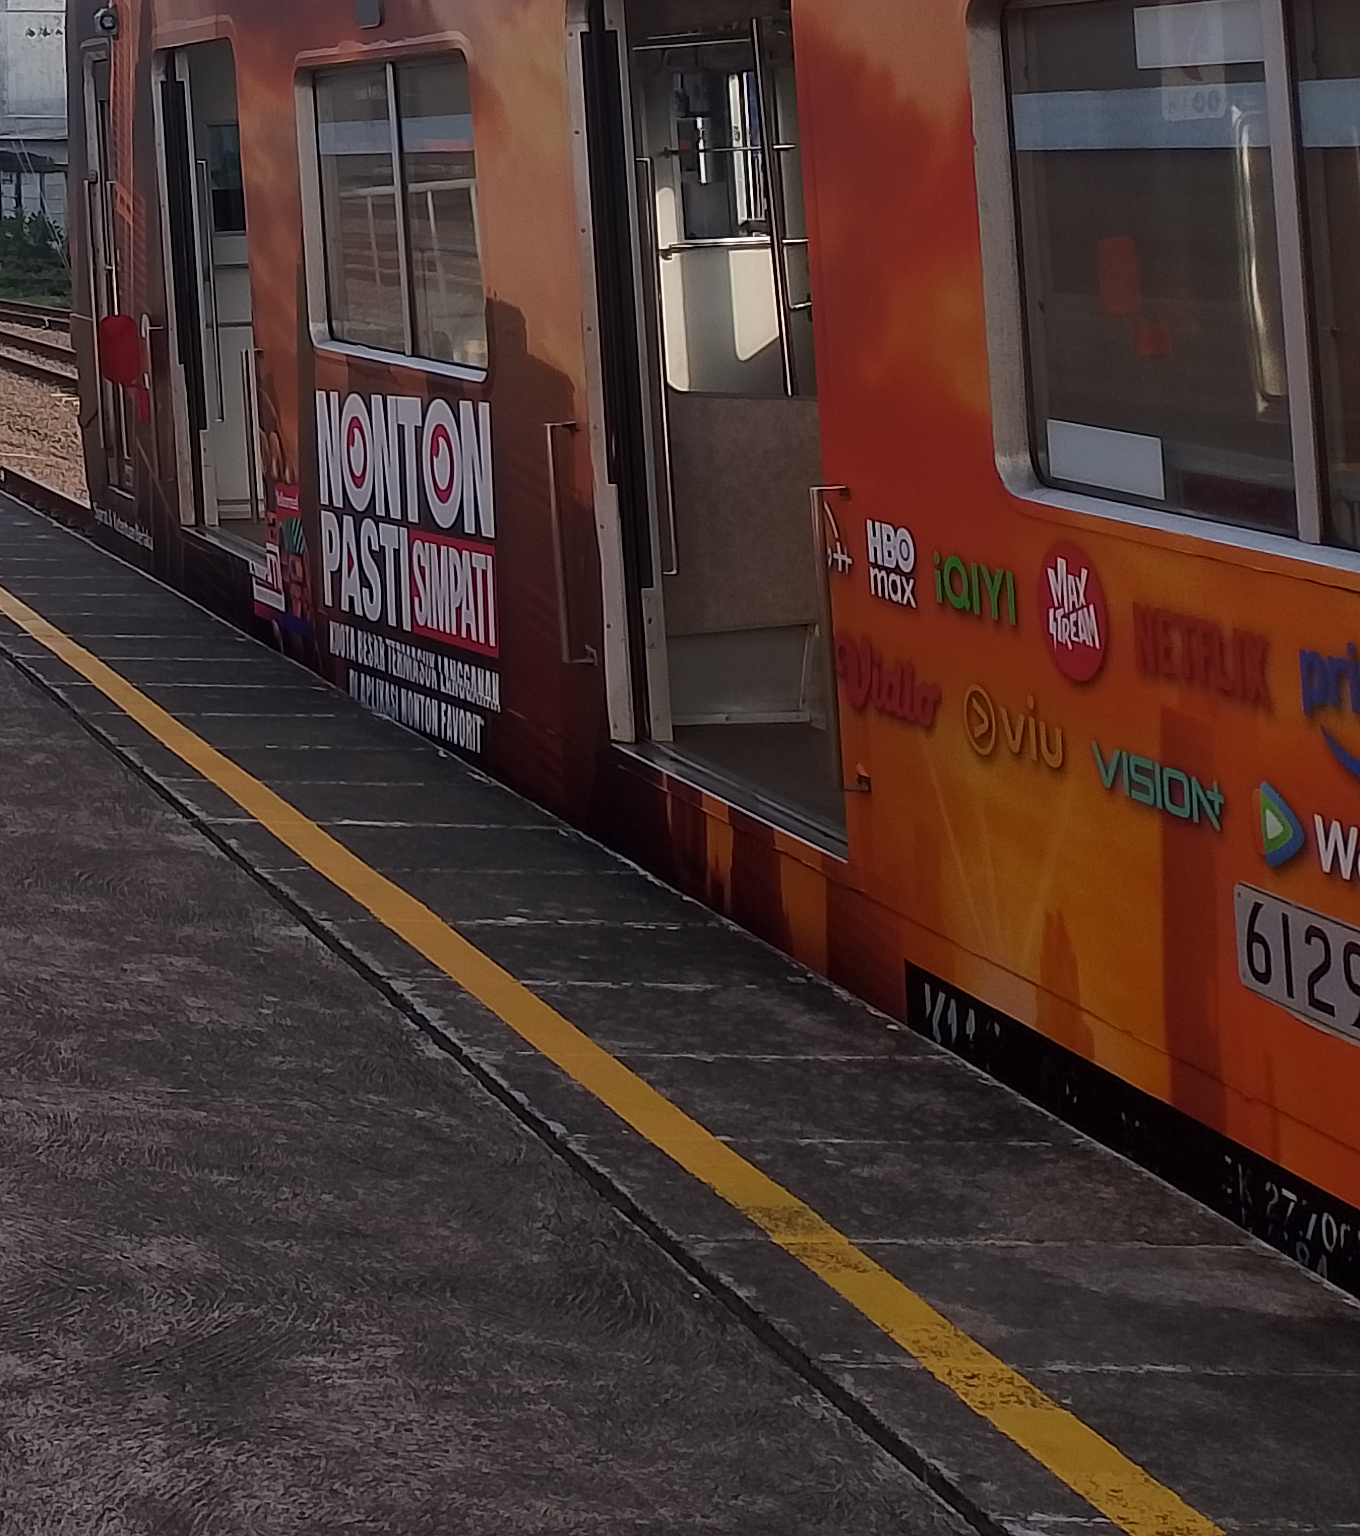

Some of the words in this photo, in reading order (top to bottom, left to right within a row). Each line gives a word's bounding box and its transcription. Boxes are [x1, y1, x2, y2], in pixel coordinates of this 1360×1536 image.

[315, 390, 496, 539] NONTON
[320, 510, 412, 632] PASTI
[412, 539, 497, 647] SIMPATI
[866, 519, 916, 573] HBO
[869, 566, 917, 609] max
[933, 550, 1017, 626] iQIYI
[1046, 556, 1090, 613] MAX
[1048, 603, 1101, 651] STREAM
[1136, 604, 1270, 707] NETFLIX
[329, 620, 356, 661] KUOTA
[357, 629, 386, 673] BESAR
[386, 639, 439, 690] TERMASUK
[438, 655, 502, 713] LANGGANAN
[401, 687, 439, 738] NONTON
[999, 694, 1064, 769] viu
[1091, 740, 1225, 832] VISION+
[1313, 813, 1360, 881] W
[1246, 901, 1360, 1029] 6129
